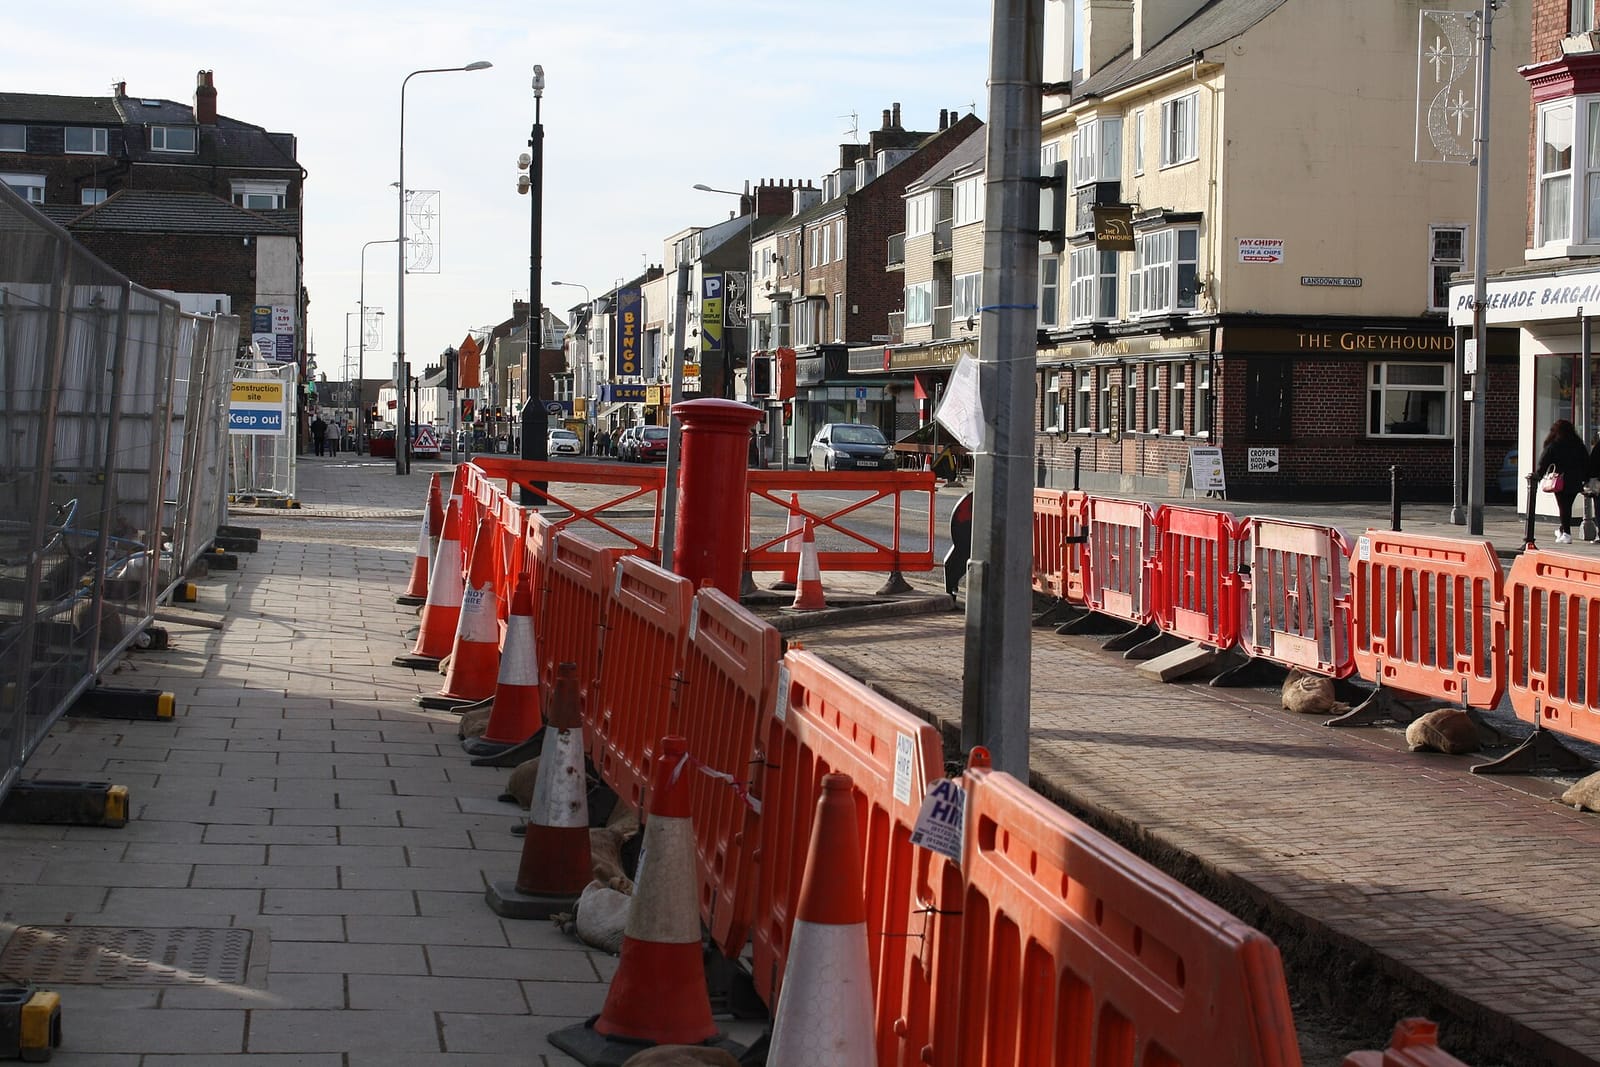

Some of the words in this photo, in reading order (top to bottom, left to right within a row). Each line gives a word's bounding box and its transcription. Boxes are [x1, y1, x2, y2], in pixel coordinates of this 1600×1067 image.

[1097, 232, 1133, 240] GREYHOUND
[1254, 239, 1283, 247] CHIPPY
[1303, 278, 1341, 286] LANSDOWNE
[705, 279, 720, 297] P
[623, 312, 635, 373] BINGO
[1297, 333, 1332, 348] THE
[1340, 332, 1454, 351] GREYHOUND
[231, 384, 279, 392] Construction
[228, 413, 257, 426] Keep
[261, 415, 279, 424] out
[1250, 449, 1276, 457] CROPPER
